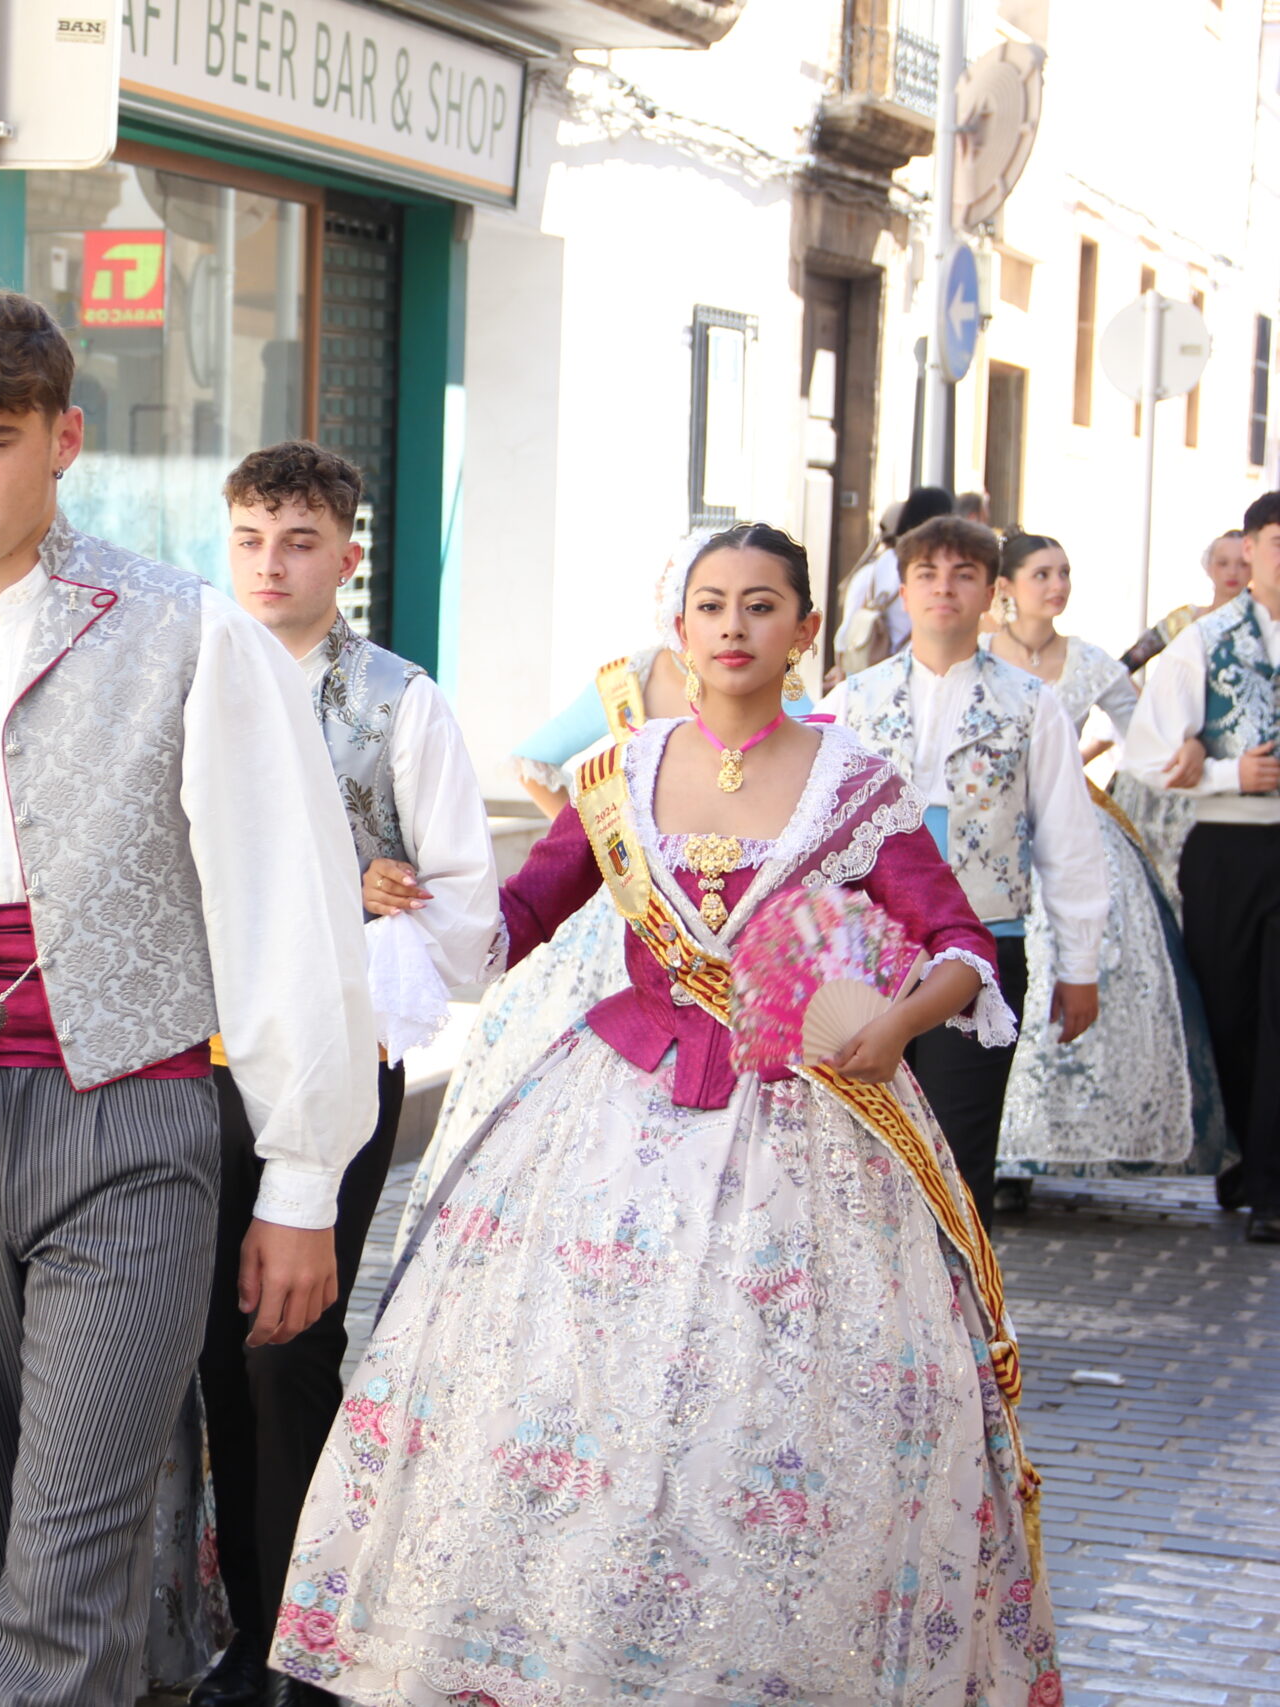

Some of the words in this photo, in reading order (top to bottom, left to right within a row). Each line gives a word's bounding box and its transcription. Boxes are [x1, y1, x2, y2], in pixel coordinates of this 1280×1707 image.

[58, 20, 101, 32] BAN
[206, 0, 297, 100] BEER
[313, 21, 376, 124] BAR
[391, 47, 412, 135] &
[426, 61, 506, 159] SHOP
[594, 802, 618, 824] 2024
